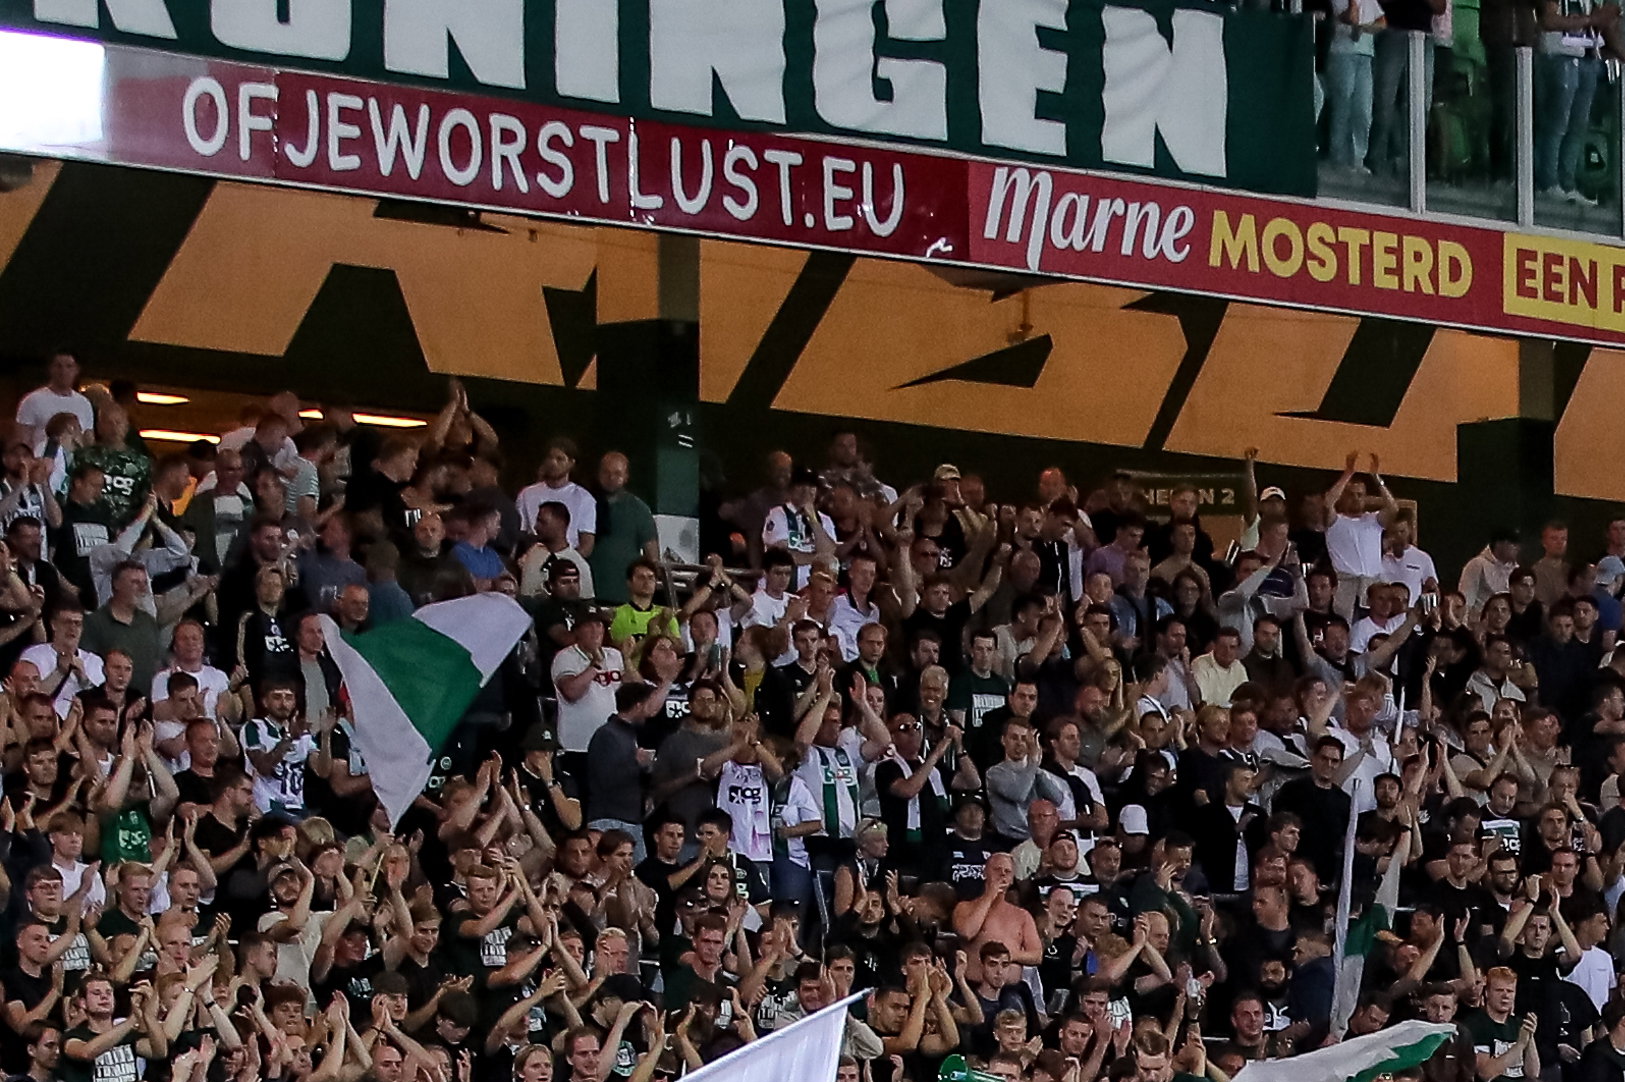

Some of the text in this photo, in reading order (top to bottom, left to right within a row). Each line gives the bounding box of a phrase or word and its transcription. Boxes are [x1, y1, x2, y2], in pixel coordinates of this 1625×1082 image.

[984, 168, 1473, 299] Marne MOSTERD
[1516, 250, 1598, 306] EEN
